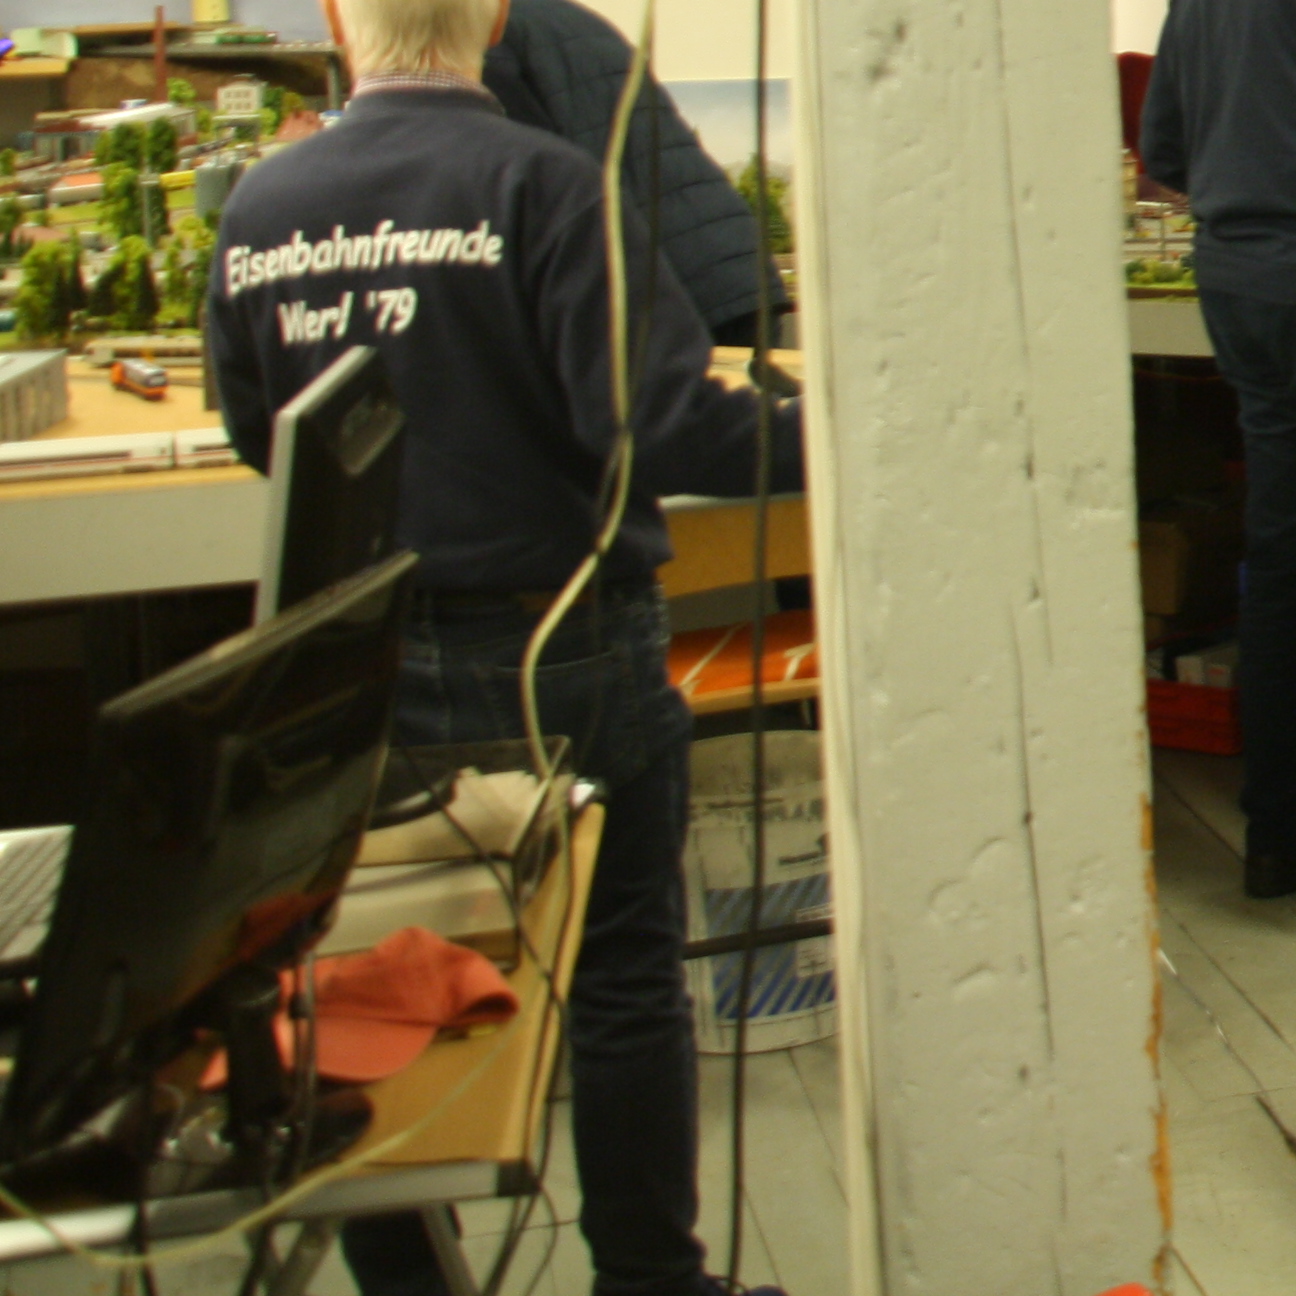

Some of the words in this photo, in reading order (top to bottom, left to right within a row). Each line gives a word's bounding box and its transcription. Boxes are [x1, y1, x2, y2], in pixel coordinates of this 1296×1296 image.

[225, 219, 503, 296] Eisenbahnfreunde
[278, 291, 354, 344] Werl
[367, 287, 417, 334] '79
